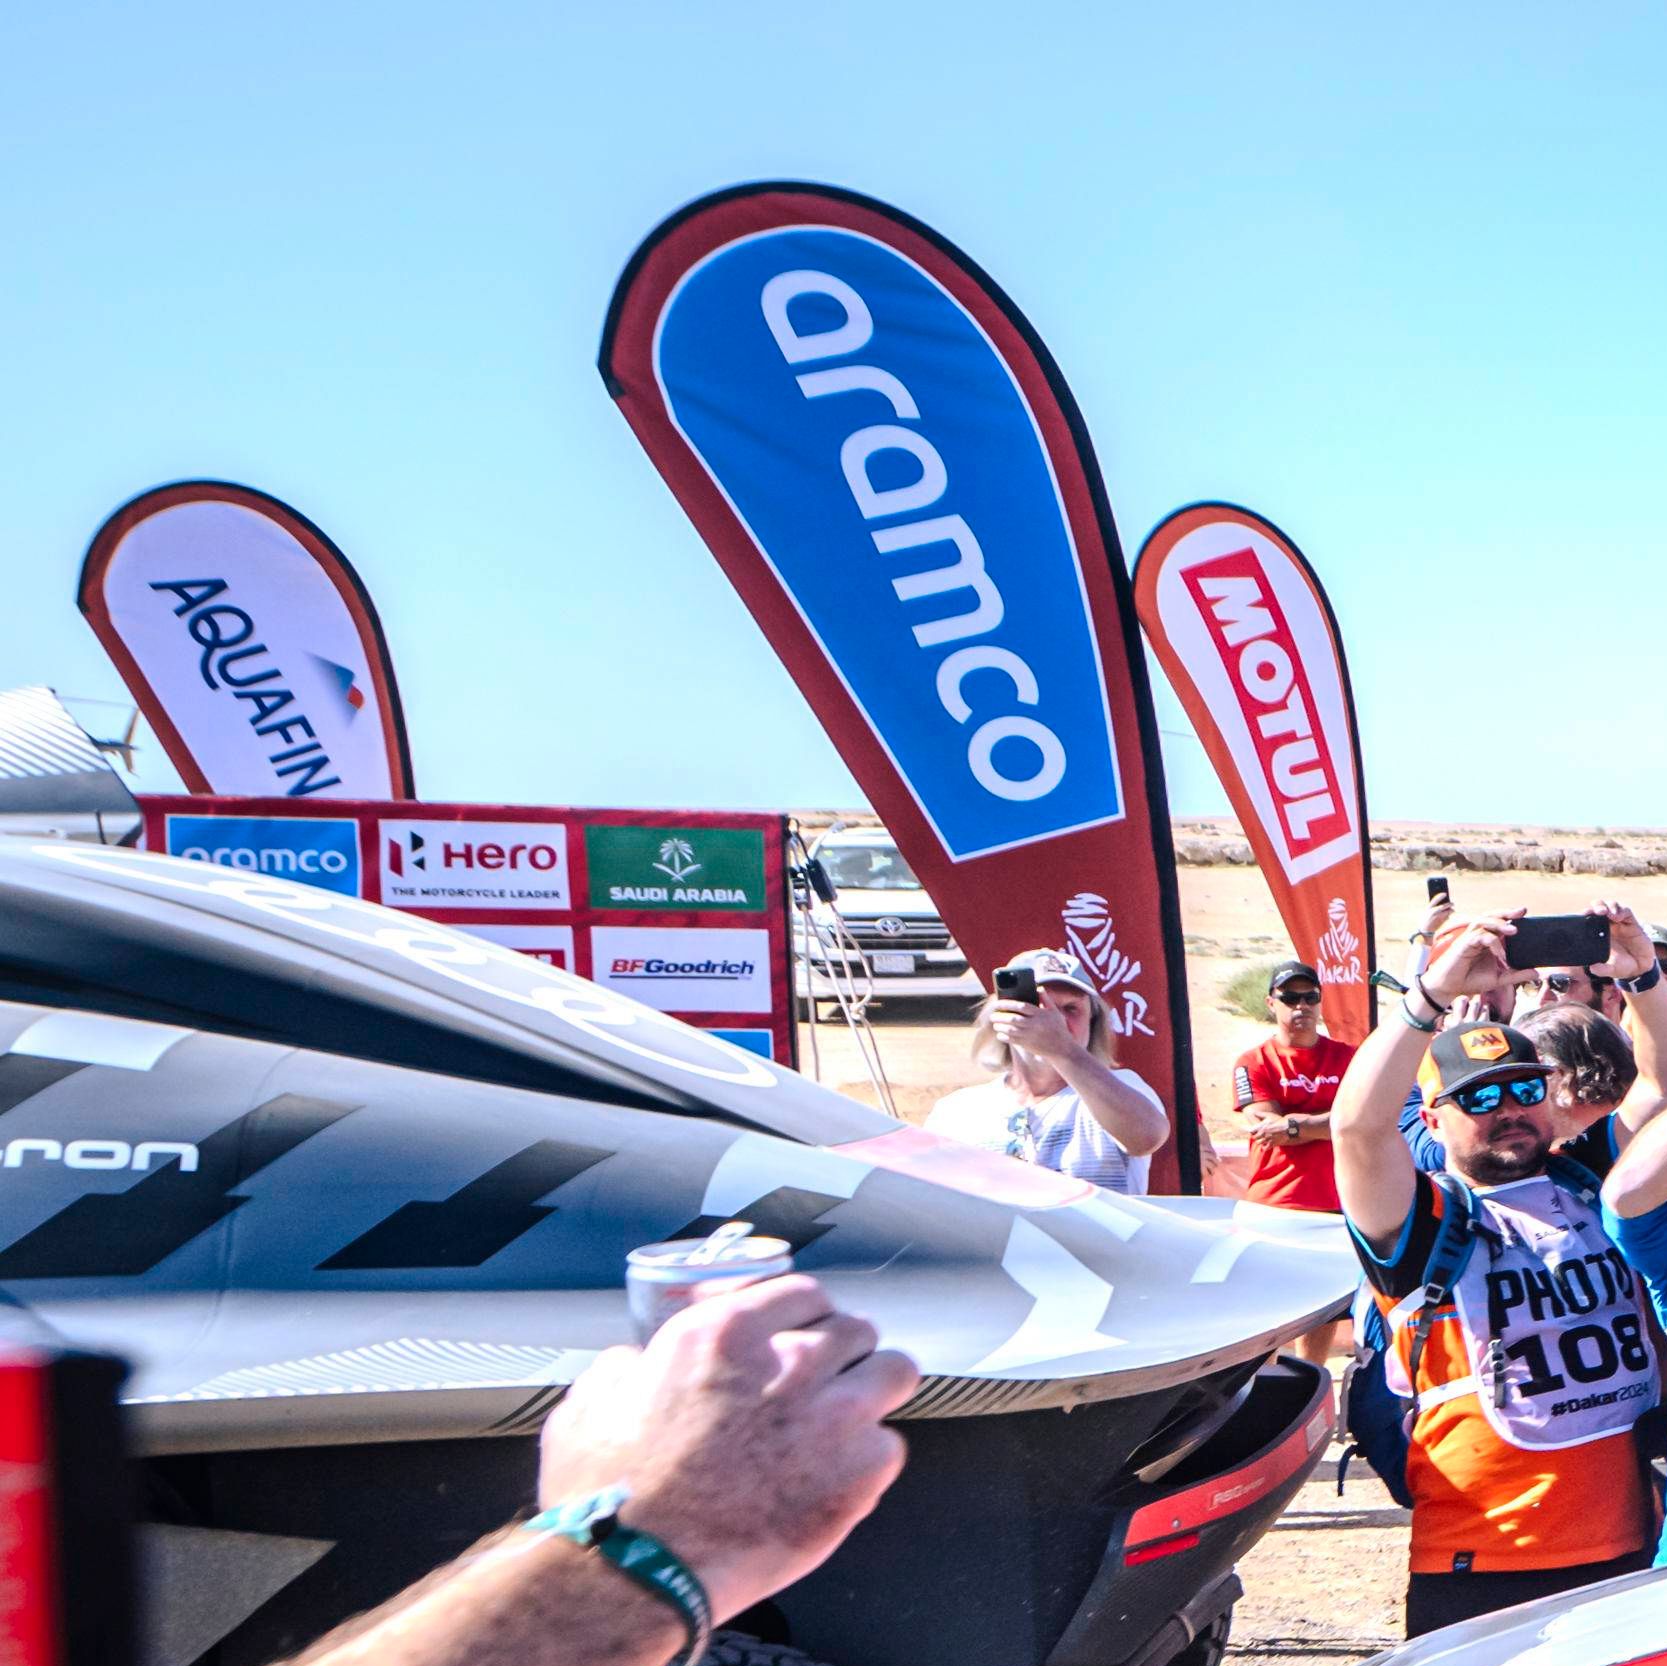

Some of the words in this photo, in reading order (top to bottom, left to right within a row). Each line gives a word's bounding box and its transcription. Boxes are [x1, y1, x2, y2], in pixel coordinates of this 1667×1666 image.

[760, 268, 1067, 802] aramco
[149, 578, 342, 796] AQUAFIN
[1199, 573, 1336, 843] MOTUL
[443, 842, 557, 870] Hero
[392, 887, 416, 896] THE
[421, 887, 506, 898] MOTORCYCLE
[510, 889, 561, 899] LEADER
[609, 887, 668, 901] SAUDI
[672, 887, 748, 904] ARABIA
[611, 959, 754, 976] BFGoodrich
[1317, 956, 1364, 985] DAKAR
[0, 1138, 200, 1172] ron
[1485, 1247, 1636, 1336] PHOTO
[1505, 1313, 1649, 1398] 108
